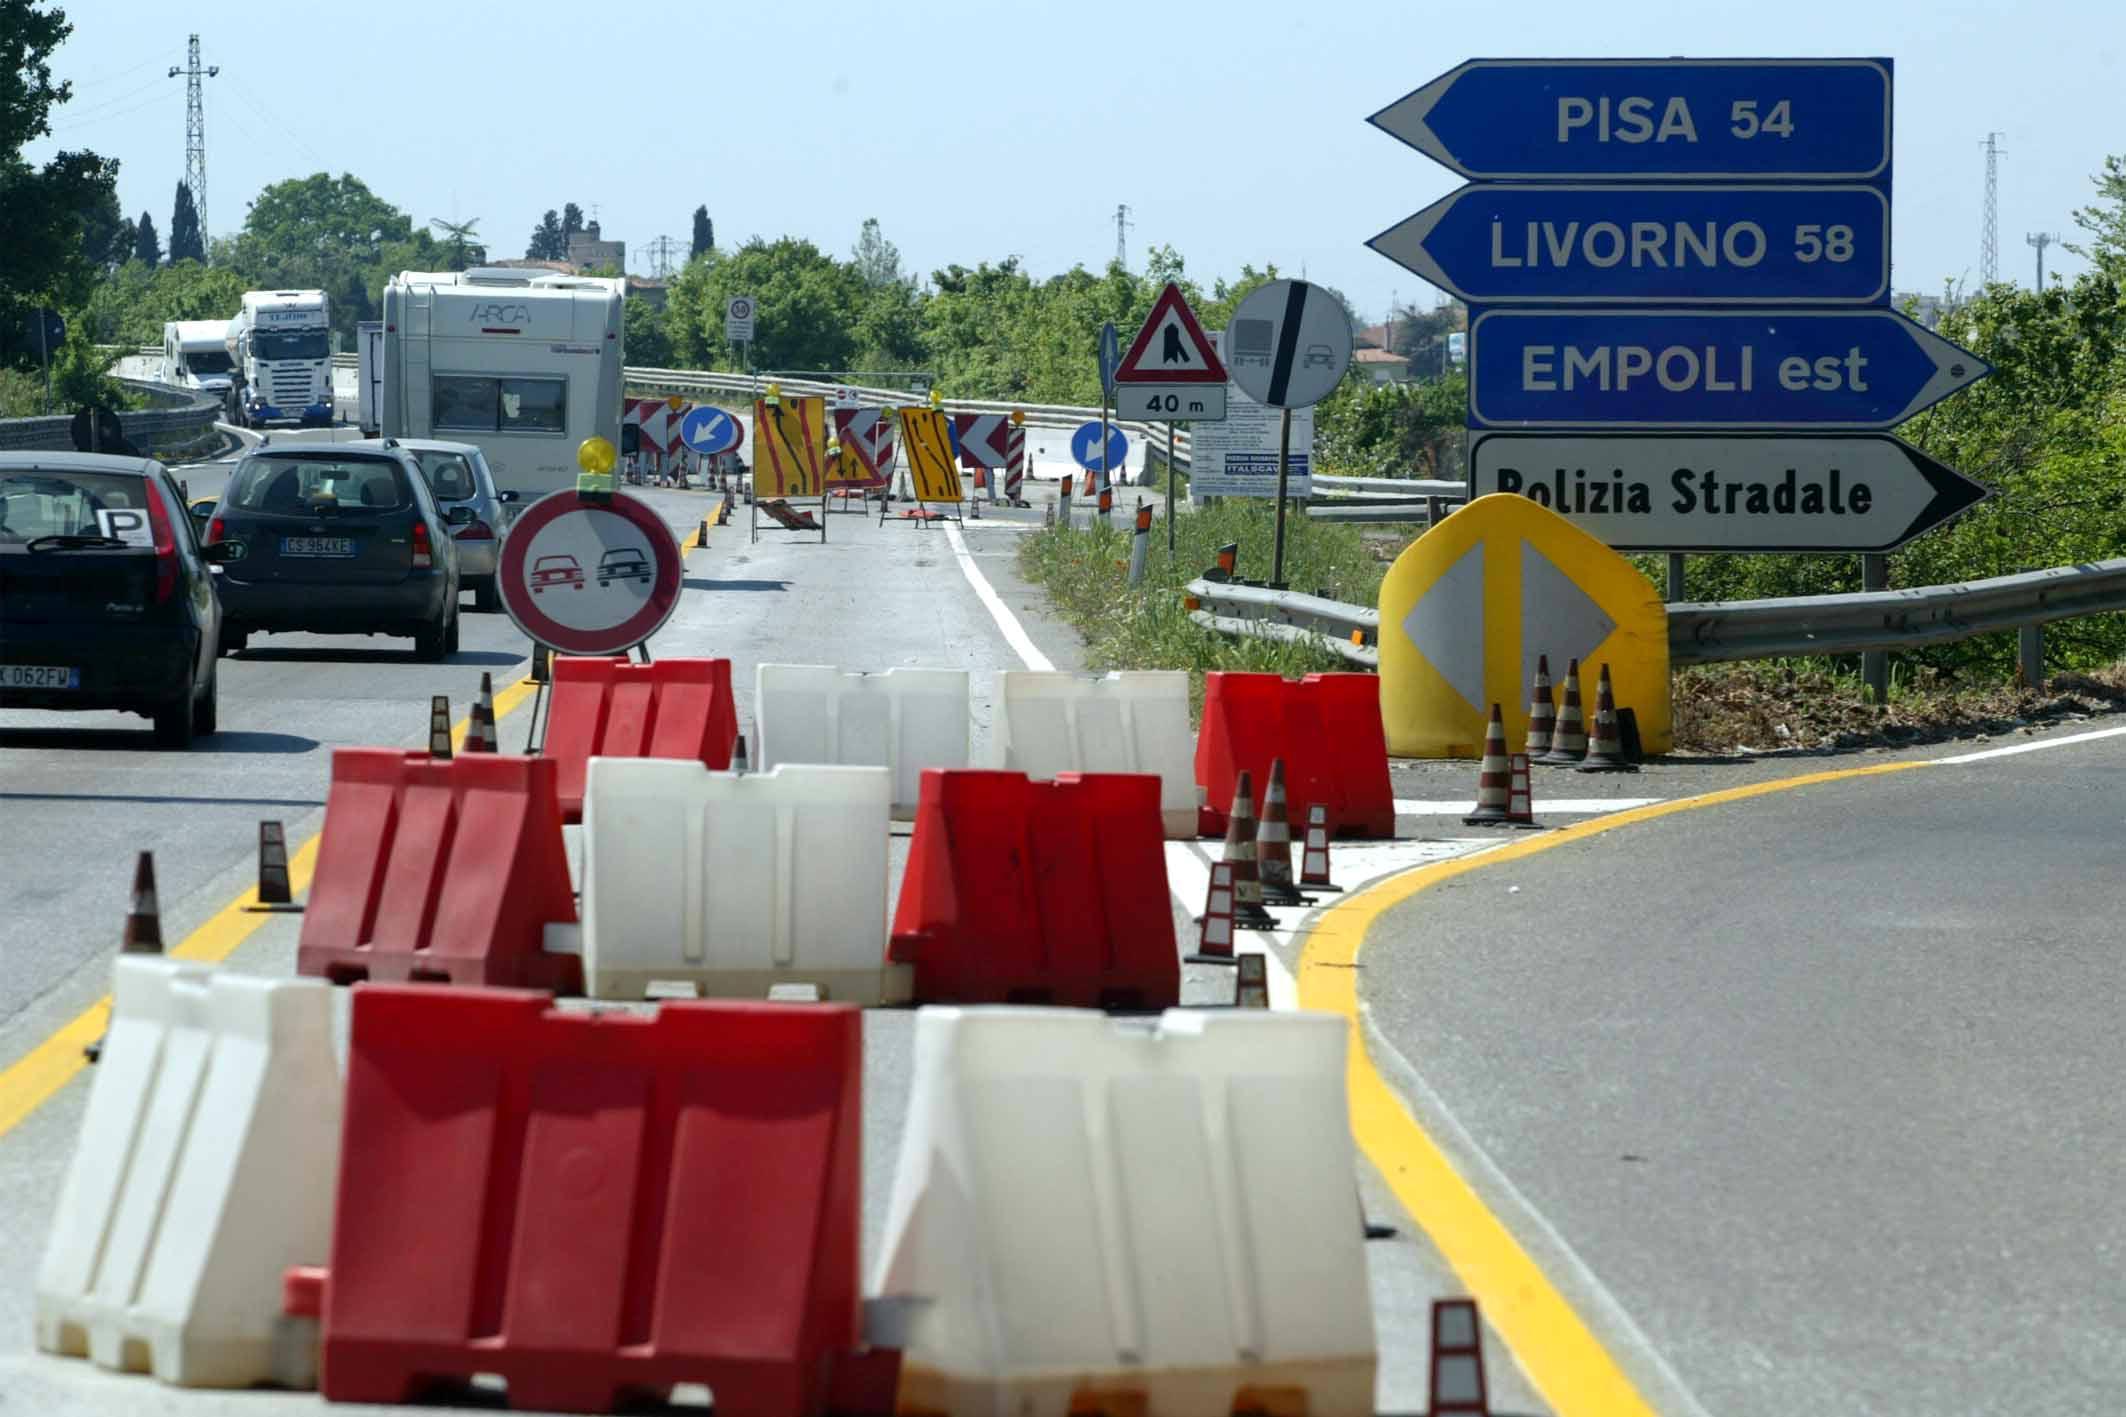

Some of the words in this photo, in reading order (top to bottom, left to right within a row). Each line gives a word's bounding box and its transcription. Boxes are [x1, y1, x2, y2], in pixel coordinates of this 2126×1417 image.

[1556, 96, 1698, 143] PISA
[1730, 100, 1795, 139] 54
[1491, 221, 1768, 268] LIVORNO
[1794, 224, 1855, 263] 58
[470, 304, 531, 323] ARCA
[1522, 345, 1753, 392] EMPOLI
[1778, 346, 1869, 392] est
[1146, 394, 1180, 412] 40
[1189, 401, 1204, 412] m
[1497, 468, 1652, 514] Polizia
[1671, 468, 1873, 515] Stradale
[105, 511, 143, 540] P
